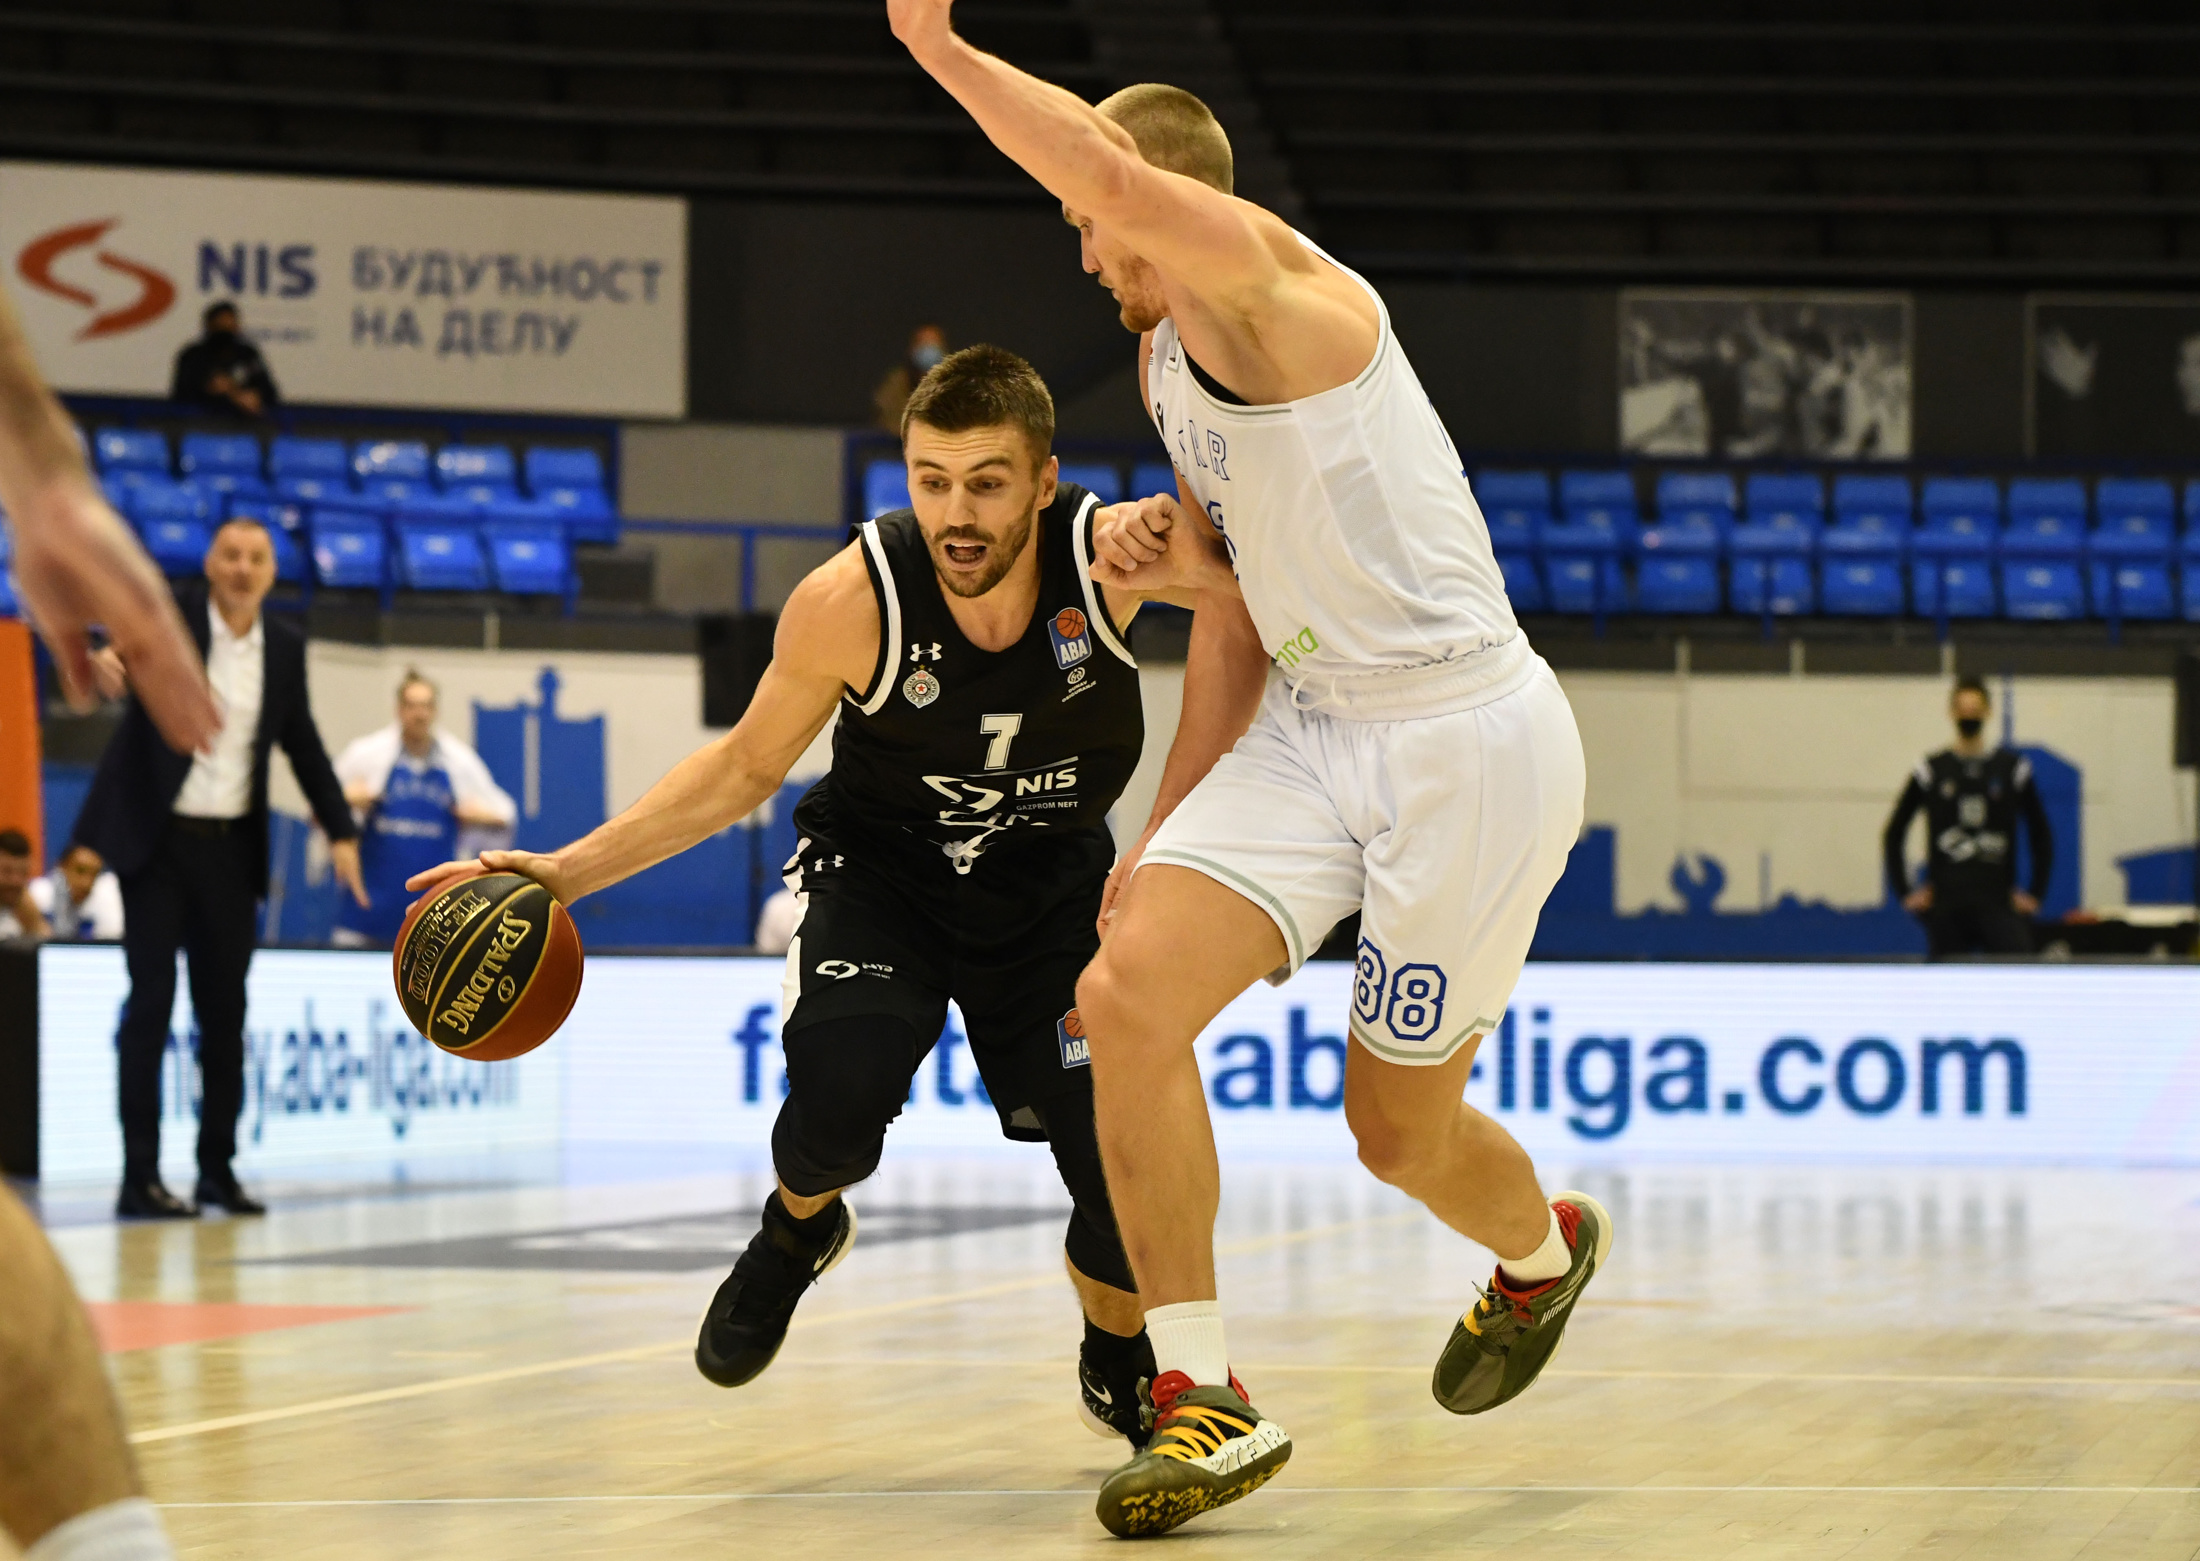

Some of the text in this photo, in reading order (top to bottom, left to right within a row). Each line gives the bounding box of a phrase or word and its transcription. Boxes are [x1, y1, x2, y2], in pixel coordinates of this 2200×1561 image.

[199, 241, 316, 298] NIS
[351, 304, 579, 358] НА ДЕЛУ
[1060, 638, 1088, 664] ABA
[980, 713, 1023, 770] 7
[1016, 767, 1077, 796] NIS
[1016, 801, 1056, 811] GAZPROM
[437, 909, 532, 1035] SPALDING
[1355, 936, 1447, 1041] 88
[1065, 1039, 1090, 1063] ABA
